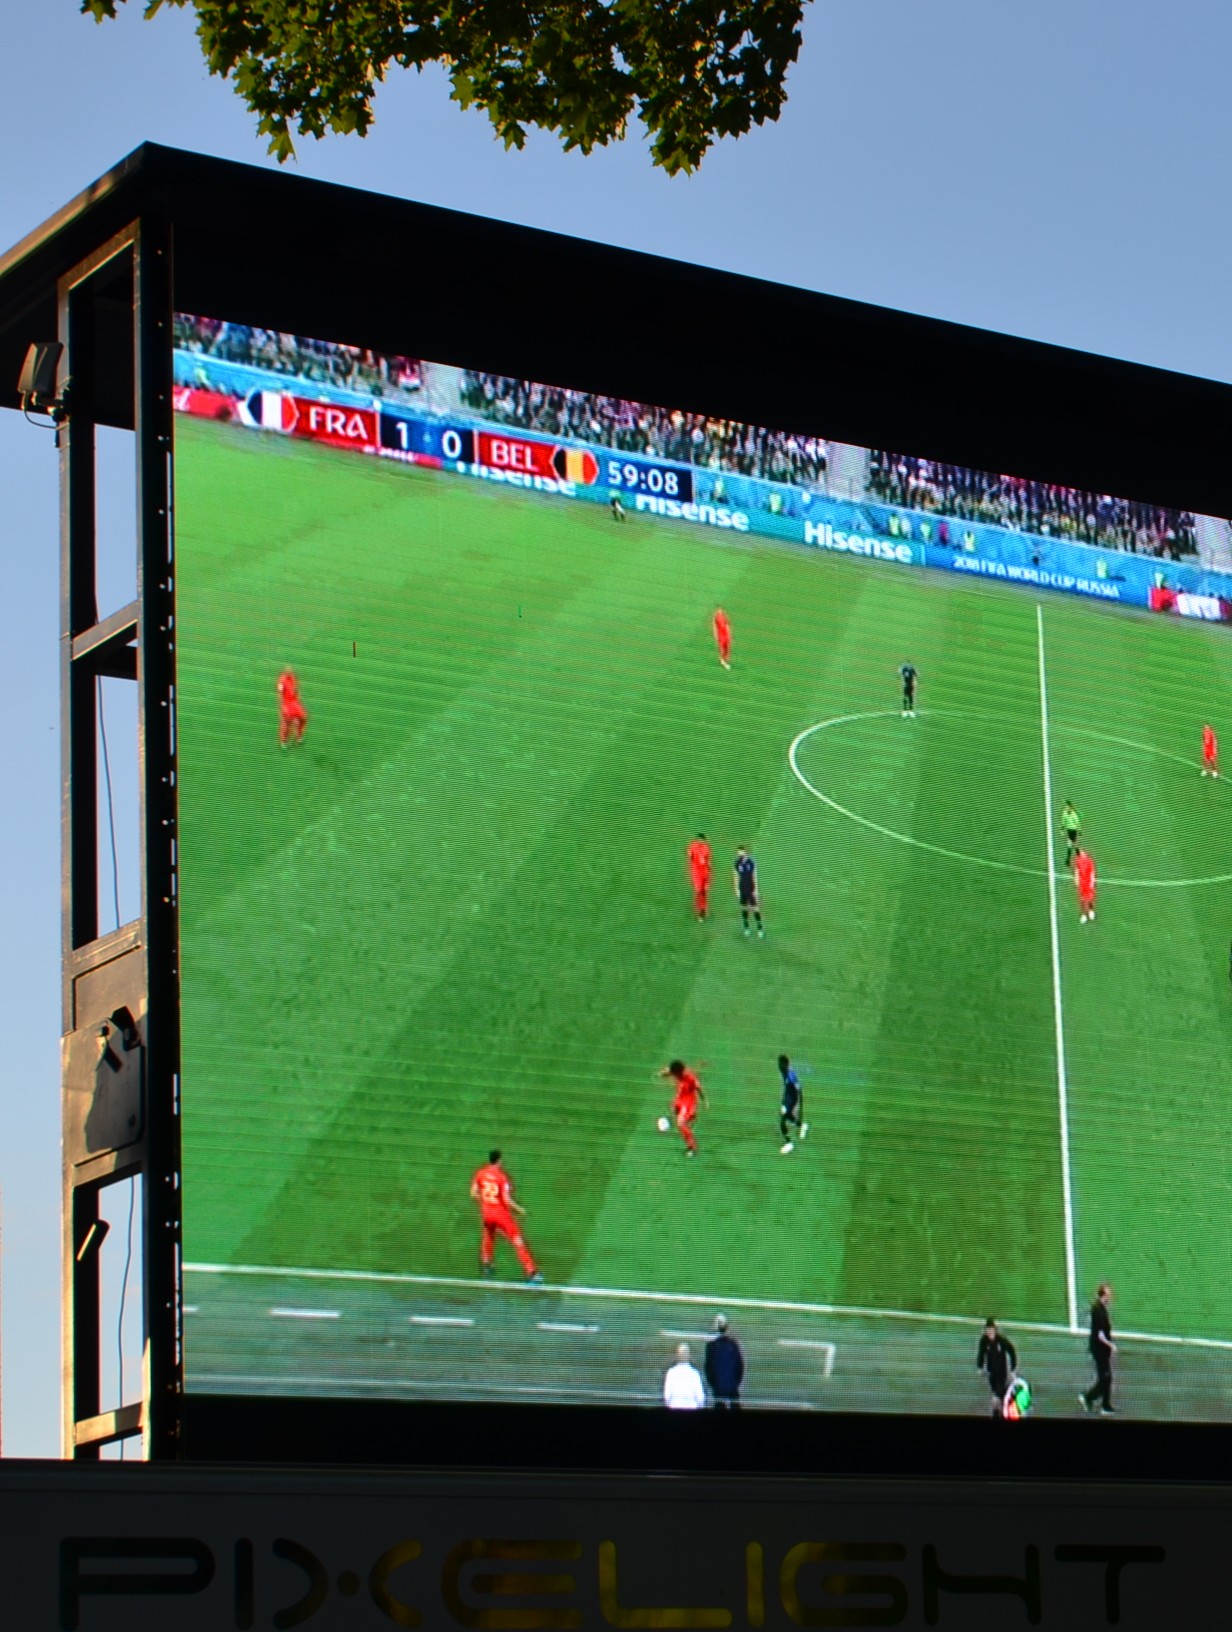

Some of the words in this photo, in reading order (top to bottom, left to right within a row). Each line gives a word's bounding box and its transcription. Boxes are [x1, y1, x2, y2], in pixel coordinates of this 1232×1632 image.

[309, 405, 368, 439] FRA
[396, 421, 408, 449] 1
[440, 430, 461, 459] 0
[491, 439, 539, 473] BEL
[608, 460, 679, 495] 59:08
[803, 519, 913, 564] Hisense
[59, 1536, 1167, 1631] PIXELIGHT
